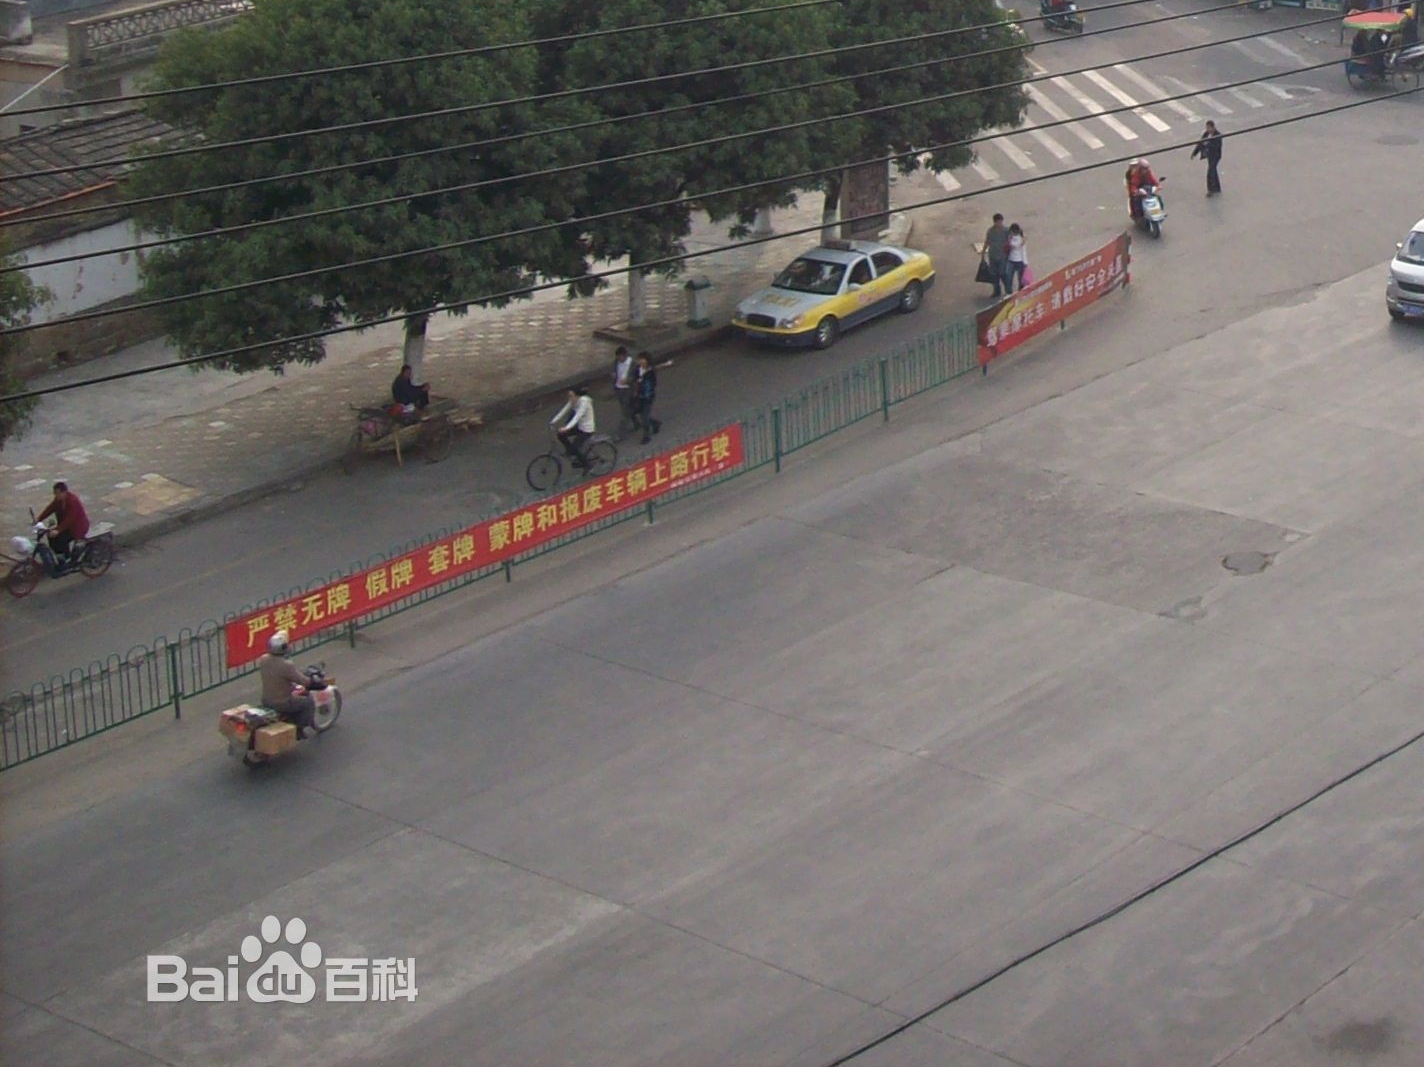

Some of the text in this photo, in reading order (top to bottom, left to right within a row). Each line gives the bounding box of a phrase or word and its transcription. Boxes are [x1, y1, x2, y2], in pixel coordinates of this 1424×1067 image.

[246, 590, 352, 649] 严禁无牌
[365, 559, 413, 598] 假牌
[427, 534, 475, 574] 套牌
[487, 434, 731, 551] 蒙牌和报废车辆上路行驶
